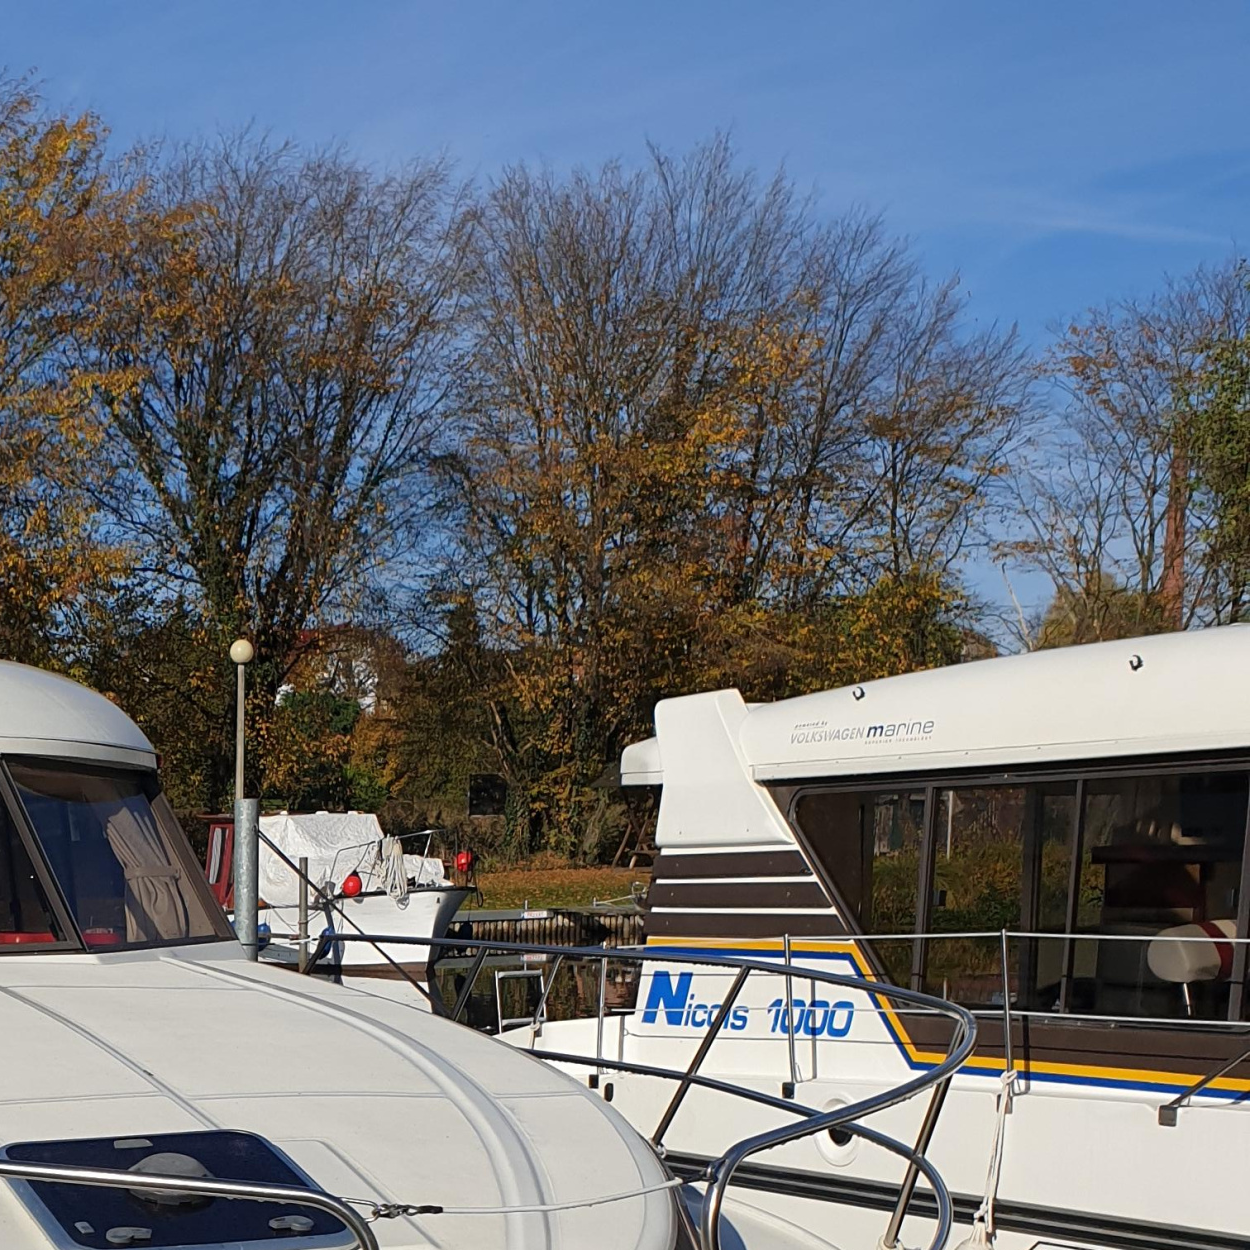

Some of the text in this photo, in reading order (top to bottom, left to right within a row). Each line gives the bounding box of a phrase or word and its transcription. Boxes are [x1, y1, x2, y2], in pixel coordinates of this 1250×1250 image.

[790, 719, 935, 744] VOLKSWAGEN marine
[767, 998, 855, 1038] 1000
